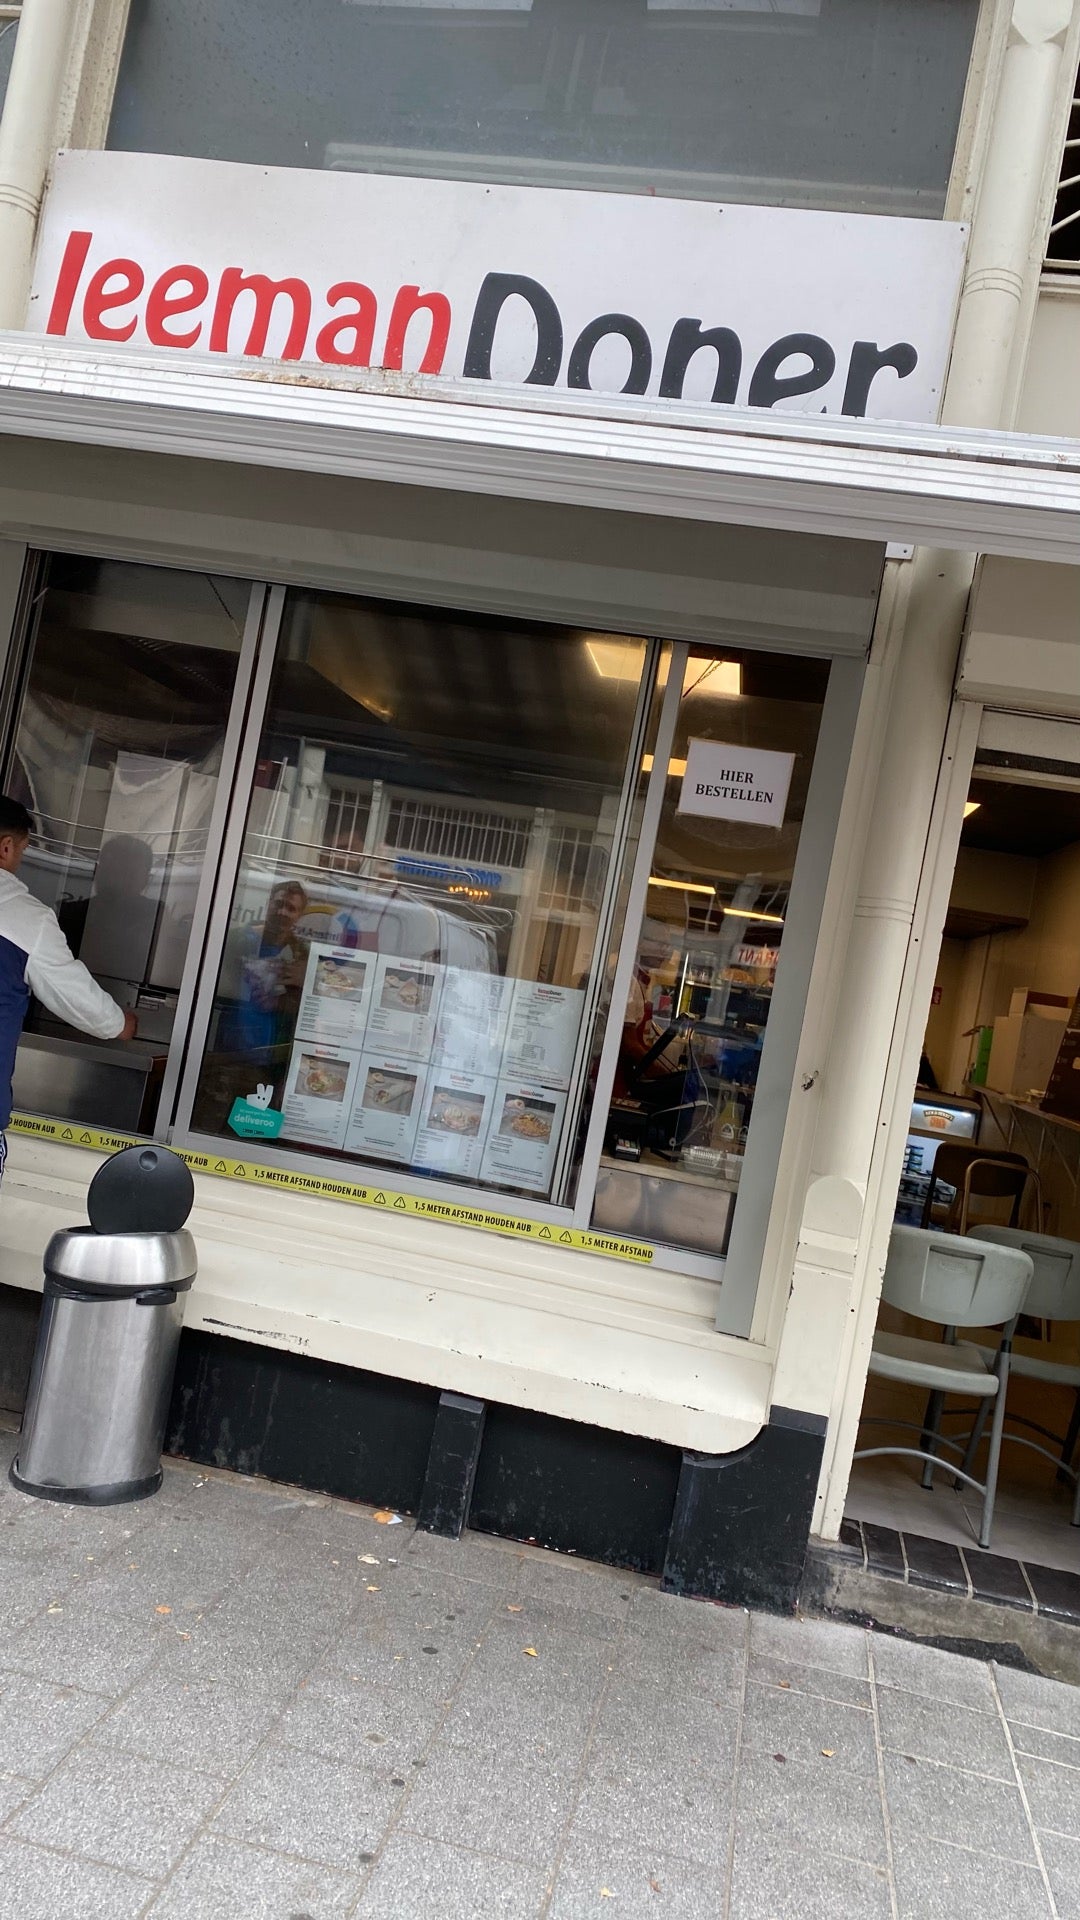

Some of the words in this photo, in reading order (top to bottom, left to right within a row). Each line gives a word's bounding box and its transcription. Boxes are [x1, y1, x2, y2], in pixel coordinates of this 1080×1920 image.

[720, 769, 753, 784] HIER
[695, 783, 774, 803] BESTELLEN
[13, 1118, 41, 1131] HOUDEN
[41, 1124, 56, 1134] AUB
[234, 1114, 274, 1127] deliveroo
[99, 1136, 110, 1146] 1,5
[193, 1157, 209, 1167] AUB
[254, 1169, 265, 1178] 1,5
[265, 1172, 290, 1184] METER
[289, 1176, 321, 1190] AFSTAND
[321, 1183, 352, 1196] HOUDEN
[351, 1188, 368, 1199] AUB
[414, 1201, 426, 1211] 1,5
[426, 1204, 451, 1216] METER
[451, 1208, 484, 1223] AFSTAND
[484, 1215, 515, 1229] HOUDEN
[515, 1221, 532, 1233] AUB
[580, 1236, 593, 1246] 1,5
[593, 1238, 619, 1252] METER
[619, 1244, 654, 1259] AFSTAND
